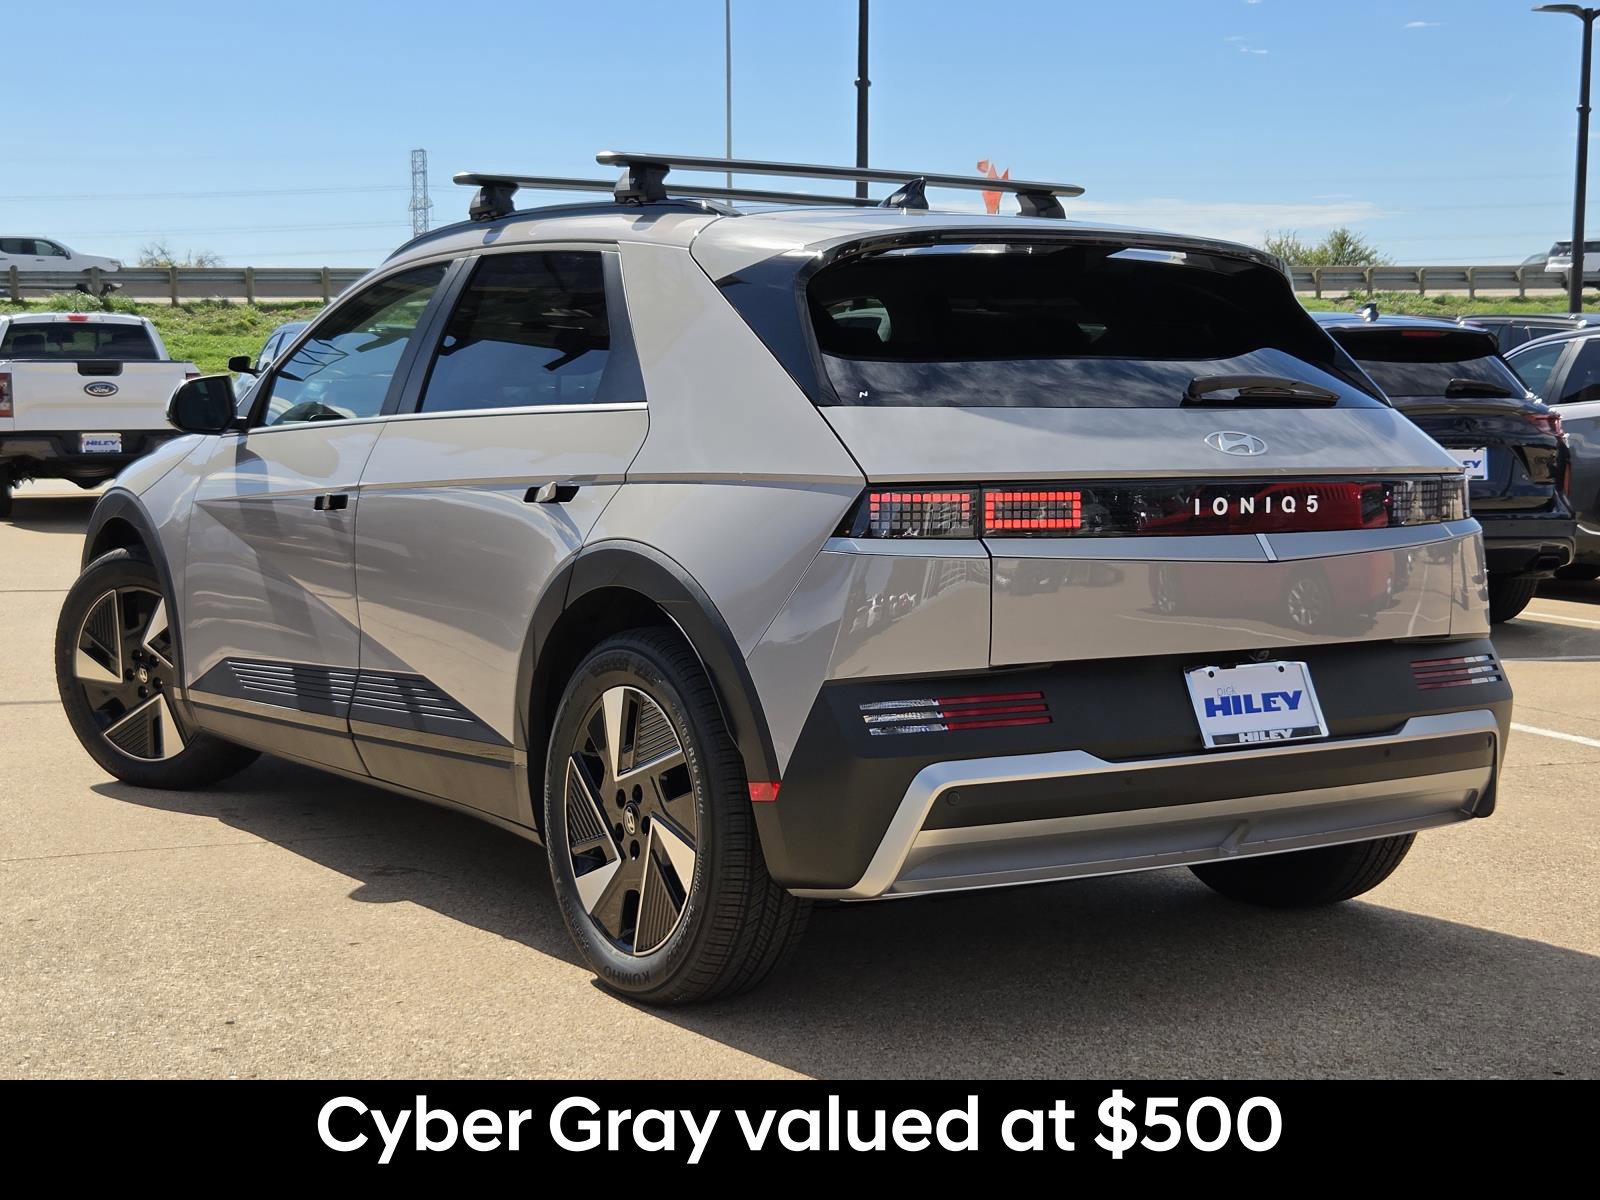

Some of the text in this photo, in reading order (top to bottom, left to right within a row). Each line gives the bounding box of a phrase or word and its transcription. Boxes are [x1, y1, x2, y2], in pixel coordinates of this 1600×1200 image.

[1194, 494, 1319, 515] IONIQ 5
[1204, 690, 1302, 717] HILEY
[1238, 728, 1293, 742] HILEY
[603, 965, 651, 985] KUMHO
